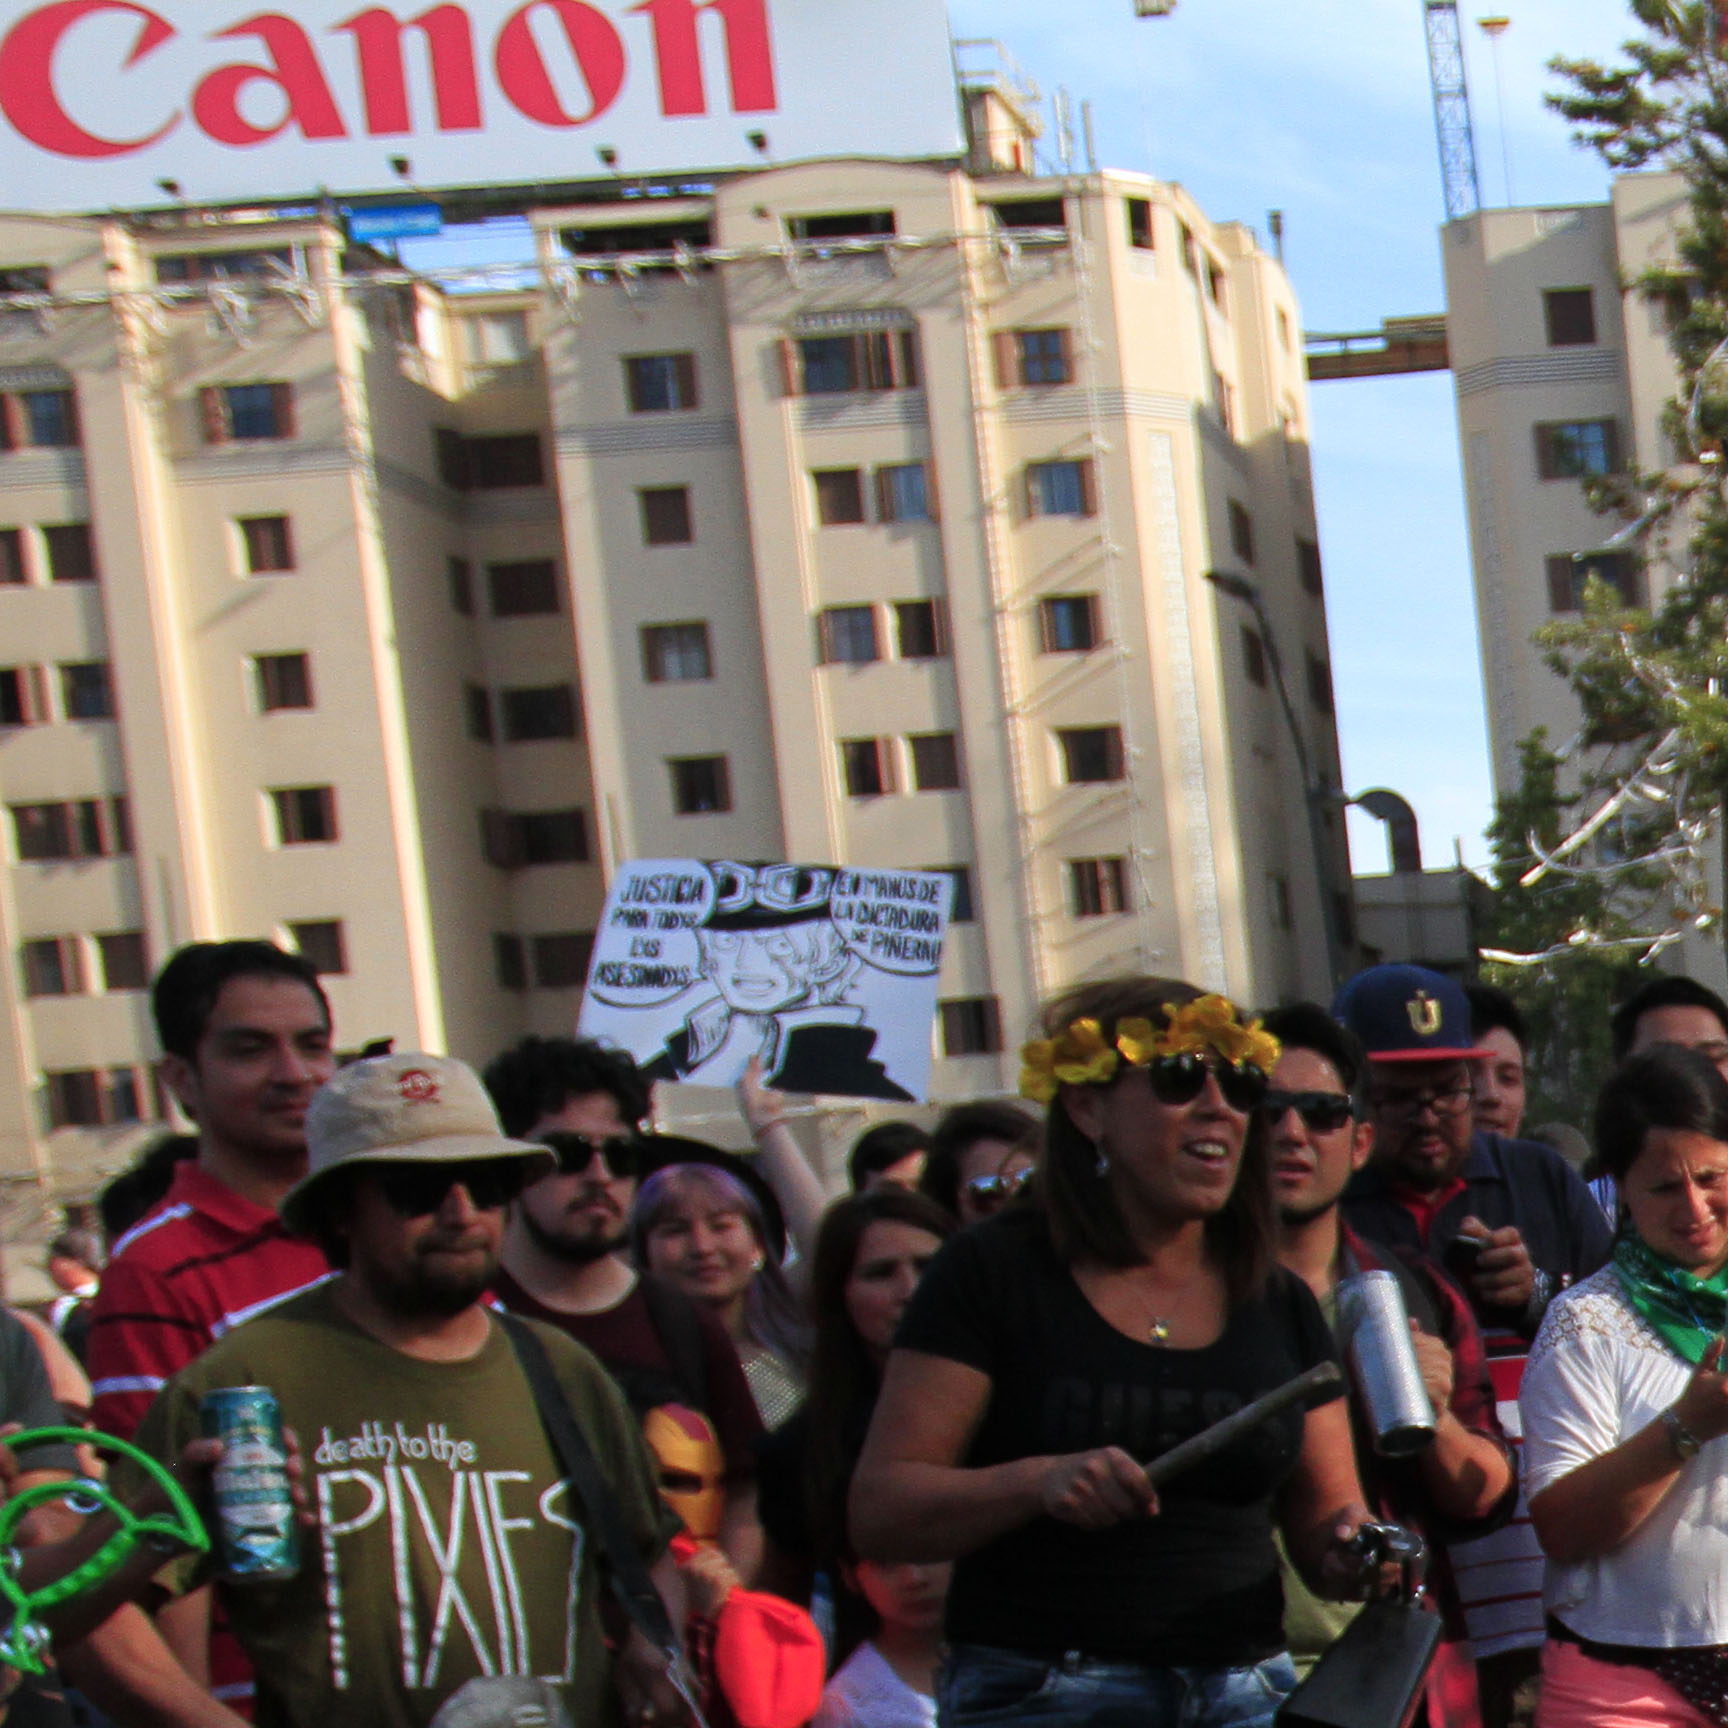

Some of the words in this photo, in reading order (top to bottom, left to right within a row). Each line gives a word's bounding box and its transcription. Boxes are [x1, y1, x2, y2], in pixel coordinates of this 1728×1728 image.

[0, 0, 778, 159] Canon
[620, 871, 705, 904] JUSTICIA
[855, 899, 940, 933] DICTADURA
[315, 1420, 397, 1466] death
[396, 1421, 428, 1460] to
[427, 1422, 479, 1470] the
